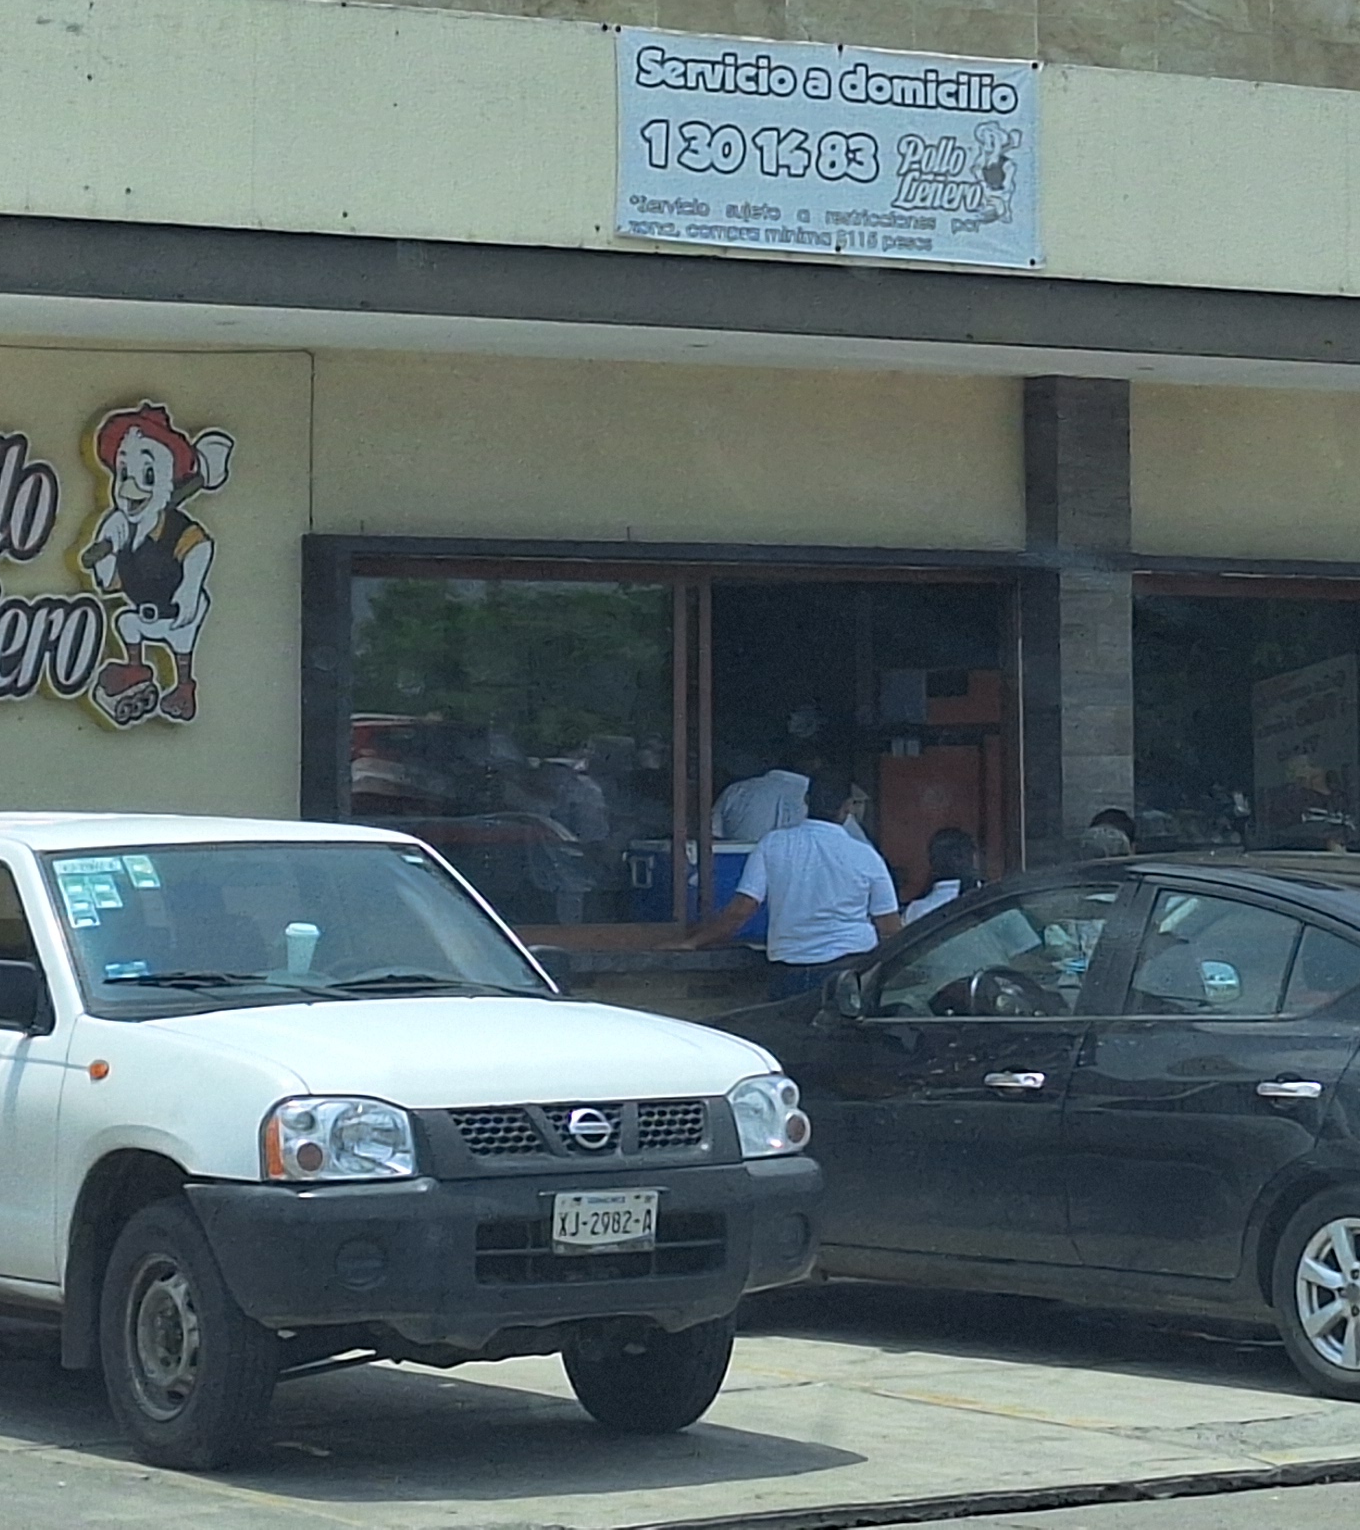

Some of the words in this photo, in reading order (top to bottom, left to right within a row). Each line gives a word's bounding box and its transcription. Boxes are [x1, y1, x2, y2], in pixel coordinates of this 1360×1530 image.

[636, 45, 797, 97] Servicio
[803, 67, 831, 99] a
[839, 62, 1019, 114] domicilio
[641, 119, 670, 169] 1
[678, 120, 747, 174] 30
[752, 126, 811, 177] 14
[816, 131, 880, 183] 83
[896, 132, 967, 177] Pollo
[725, 201, 782, 222] sujeto
[796, 208, 811, 224] a
